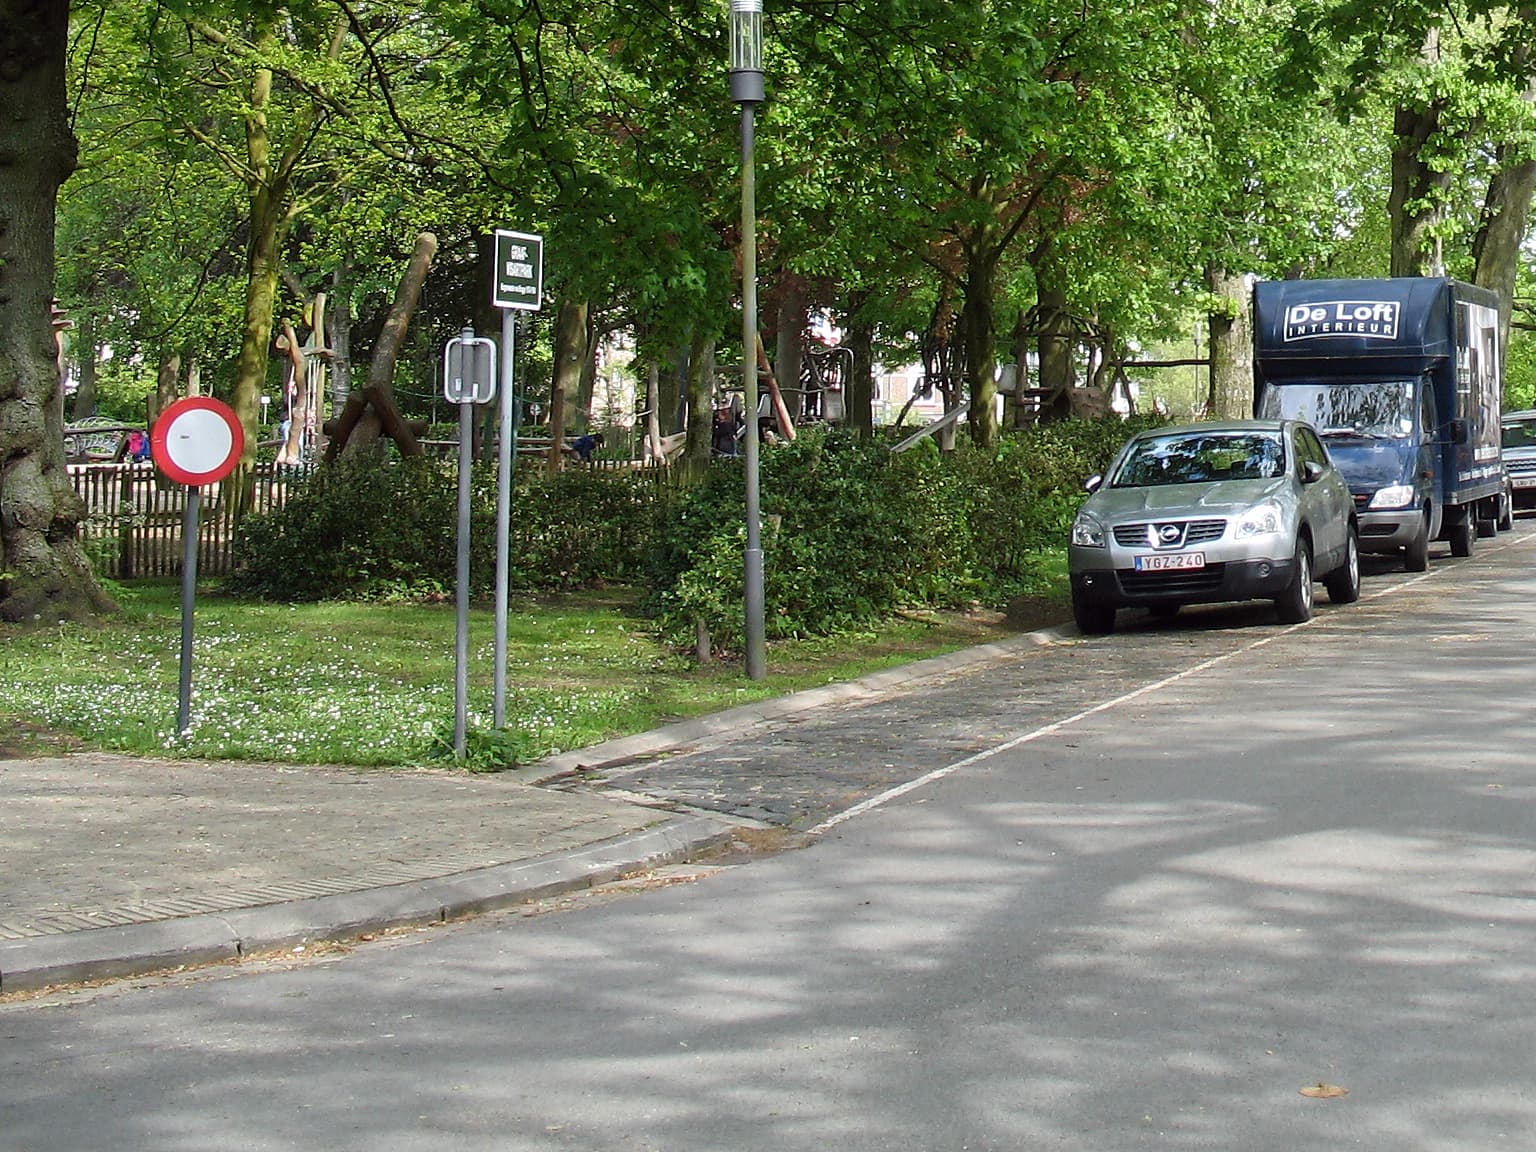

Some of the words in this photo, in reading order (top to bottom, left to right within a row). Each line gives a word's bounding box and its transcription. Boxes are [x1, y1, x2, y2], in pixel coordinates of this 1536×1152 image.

[1290, 306, 1327, 324] De
[1336, 303, 1392, 322] Loft
[1289, 322, 1392, 336] INTERIEUR
[1145, 554, 1202, 568] YGZ-240
